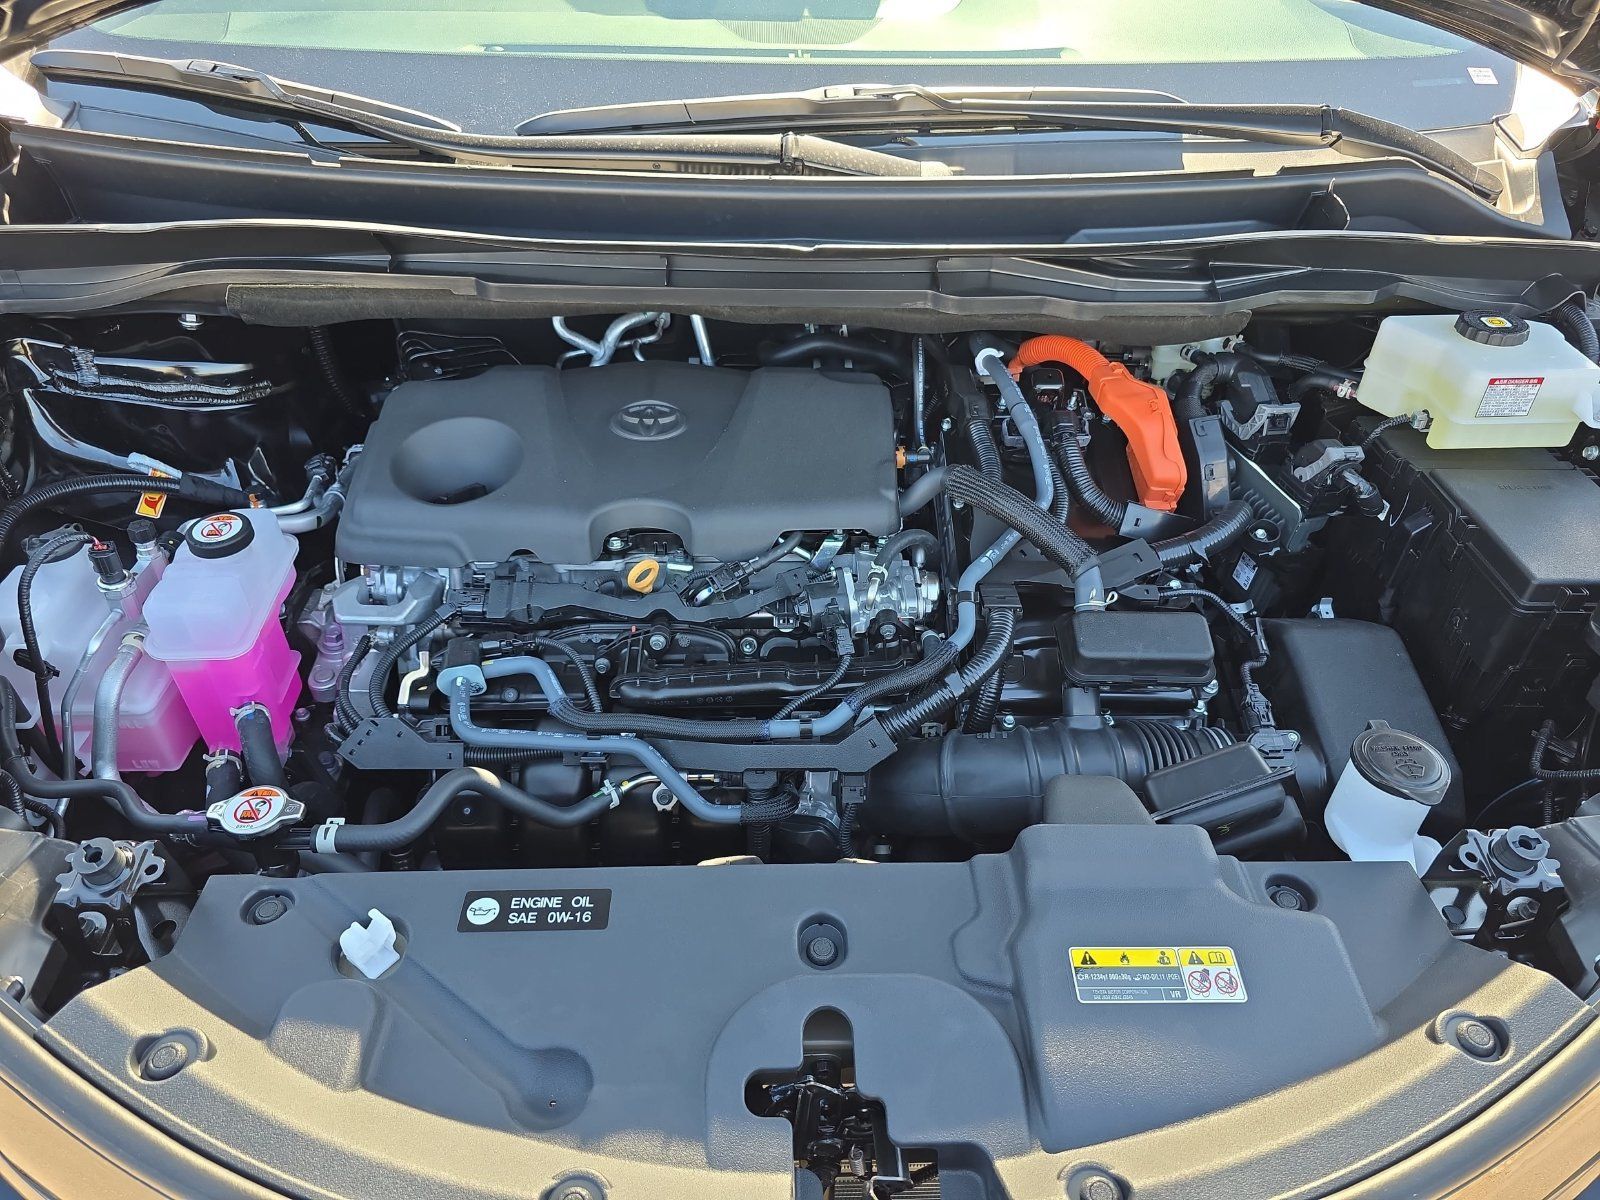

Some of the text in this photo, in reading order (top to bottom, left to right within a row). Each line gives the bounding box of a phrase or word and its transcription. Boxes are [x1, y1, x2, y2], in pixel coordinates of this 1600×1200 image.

[132, 759, 160, 769] LOW
[510, 896, 594, 909] ENGINE OIL
[507, 911, 592, 924] SAE 0W-16
[1170, 990, 1182, 998] VR
